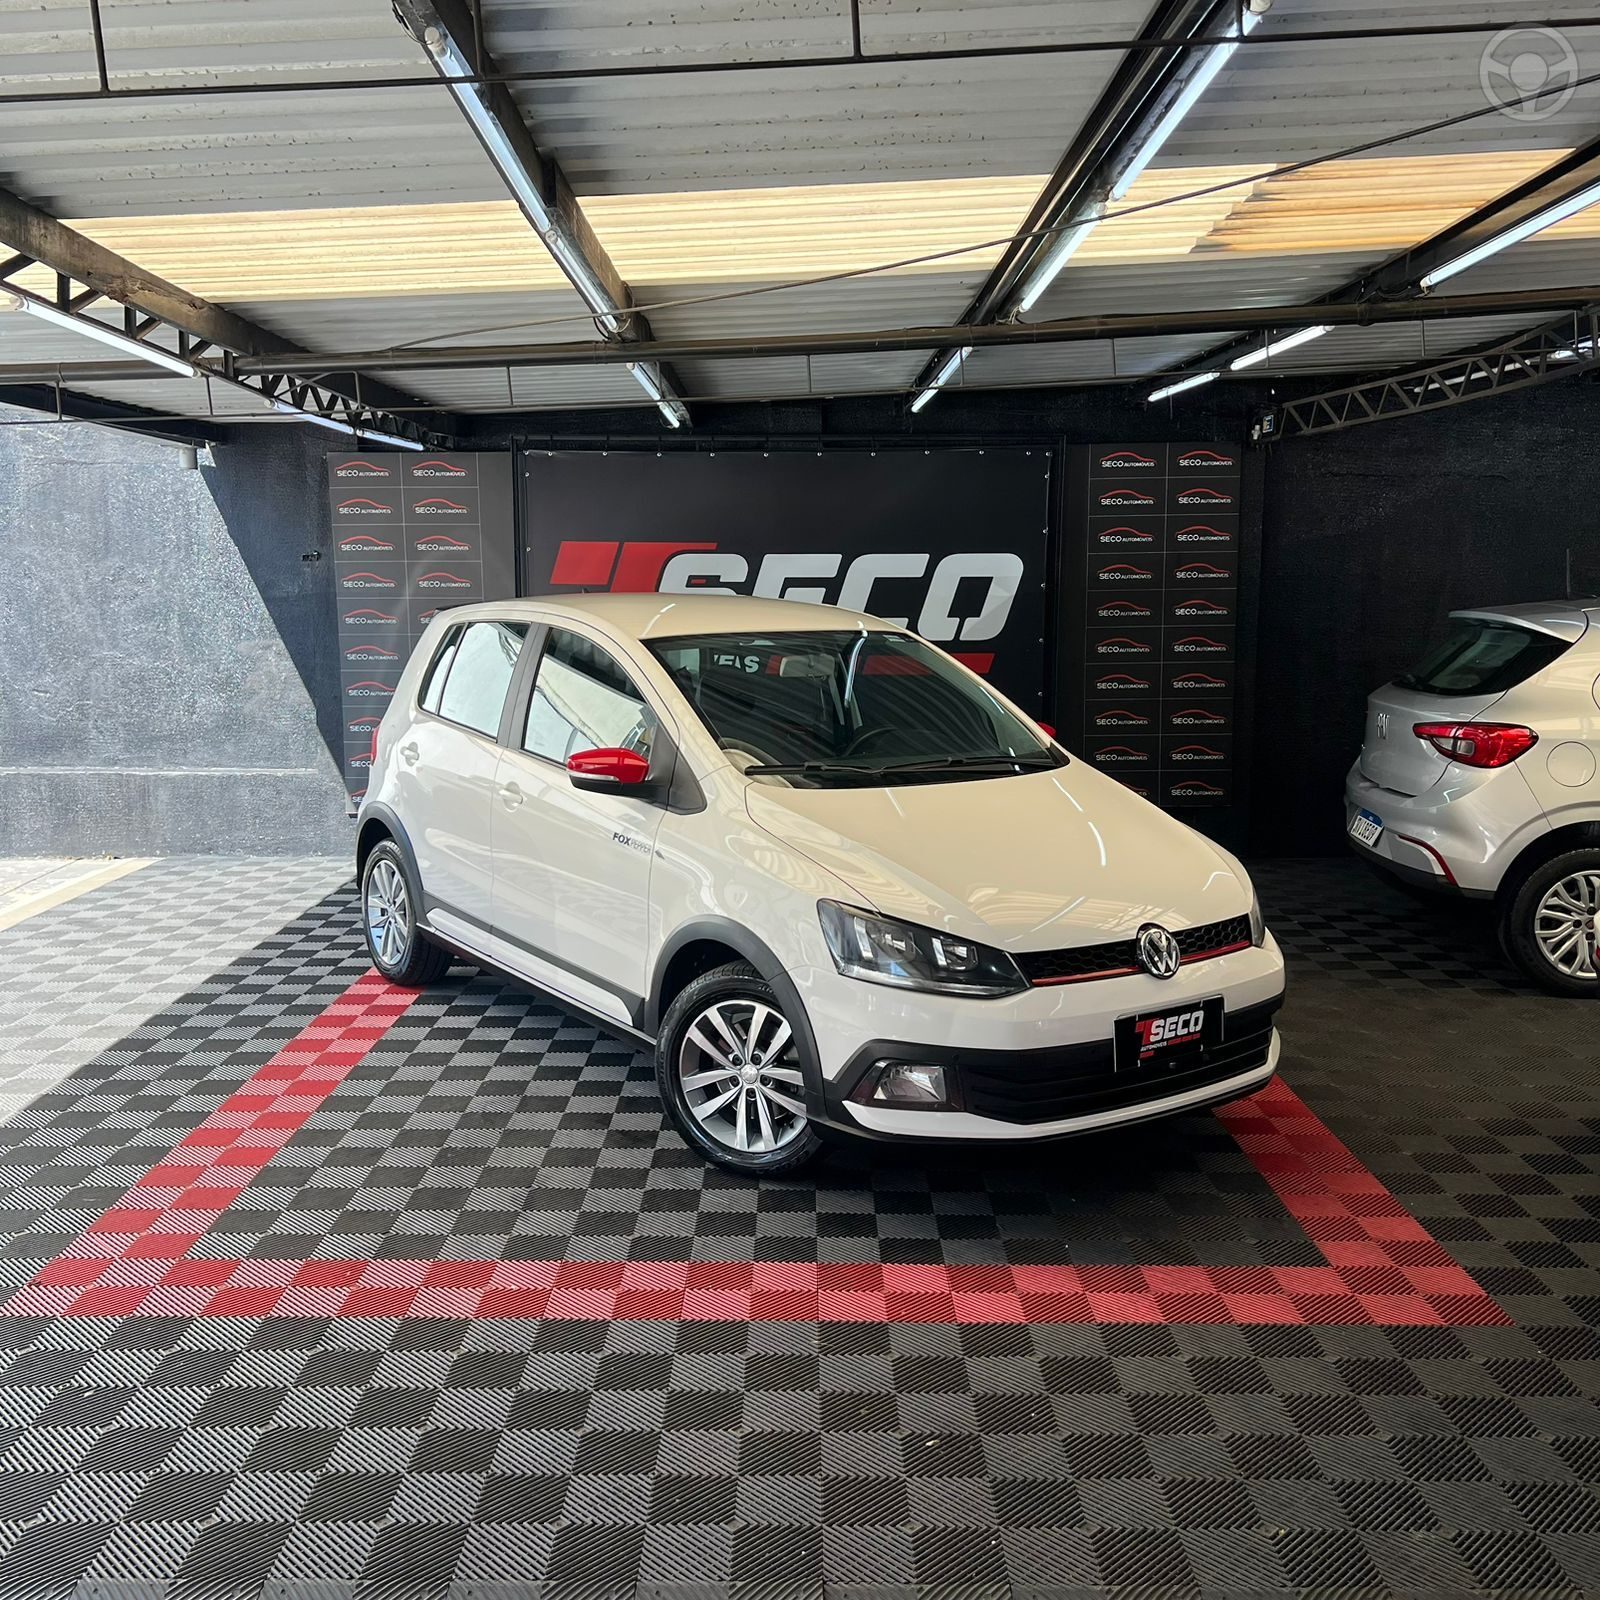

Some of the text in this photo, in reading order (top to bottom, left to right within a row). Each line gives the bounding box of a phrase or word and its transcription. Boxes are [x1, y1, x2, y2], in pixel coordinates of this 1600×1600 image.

[1101, 460, 1124, 468] SECO
[1179, 458, 1202, 467] SECO
[336, 469, 359, 477] SECO
[412, 469, 435, 477] SECO
[1178, 496, 1201, 504] SECO
[415, 506, 437, 514] SECO
[1100, 535, 1122, 543] SECO
[1177, 534, 1200, 542] SECO
[416, 543, 439, 551] SECO
[1099, 572, 1121, 580] SECO
[1176, 571, 1199, 579] SECO
[343, 580, 365, 588] SECO
[419, 580, 441, 588] SECO
[1098, 609, 1121, 617] SECO
[1175, 608, 1197, 616] SECO
[345, 617, 367, 625] SECO
[1097, 645, 1120, 653] SECO
[1174, 644, 1196, 652] SECO
[346, 653, 369, 661] SECO
[1096, 682, 1119, 690] SECO
[1173, 681, 1195, 689] SECO
[348, 689, 370, 697] SECO
[1096, 718, 1118, 726] SECO
[1172, 717, 1194, 725] SECO
[1095, 754, 1118, 762] SECO
[1171, 753, 1194, 761] SECO
[1171, 788, 1193, 797] SECO
[612, 832, 631, 846] FOX
[1150, 1010, 1204, 1042] SECO
